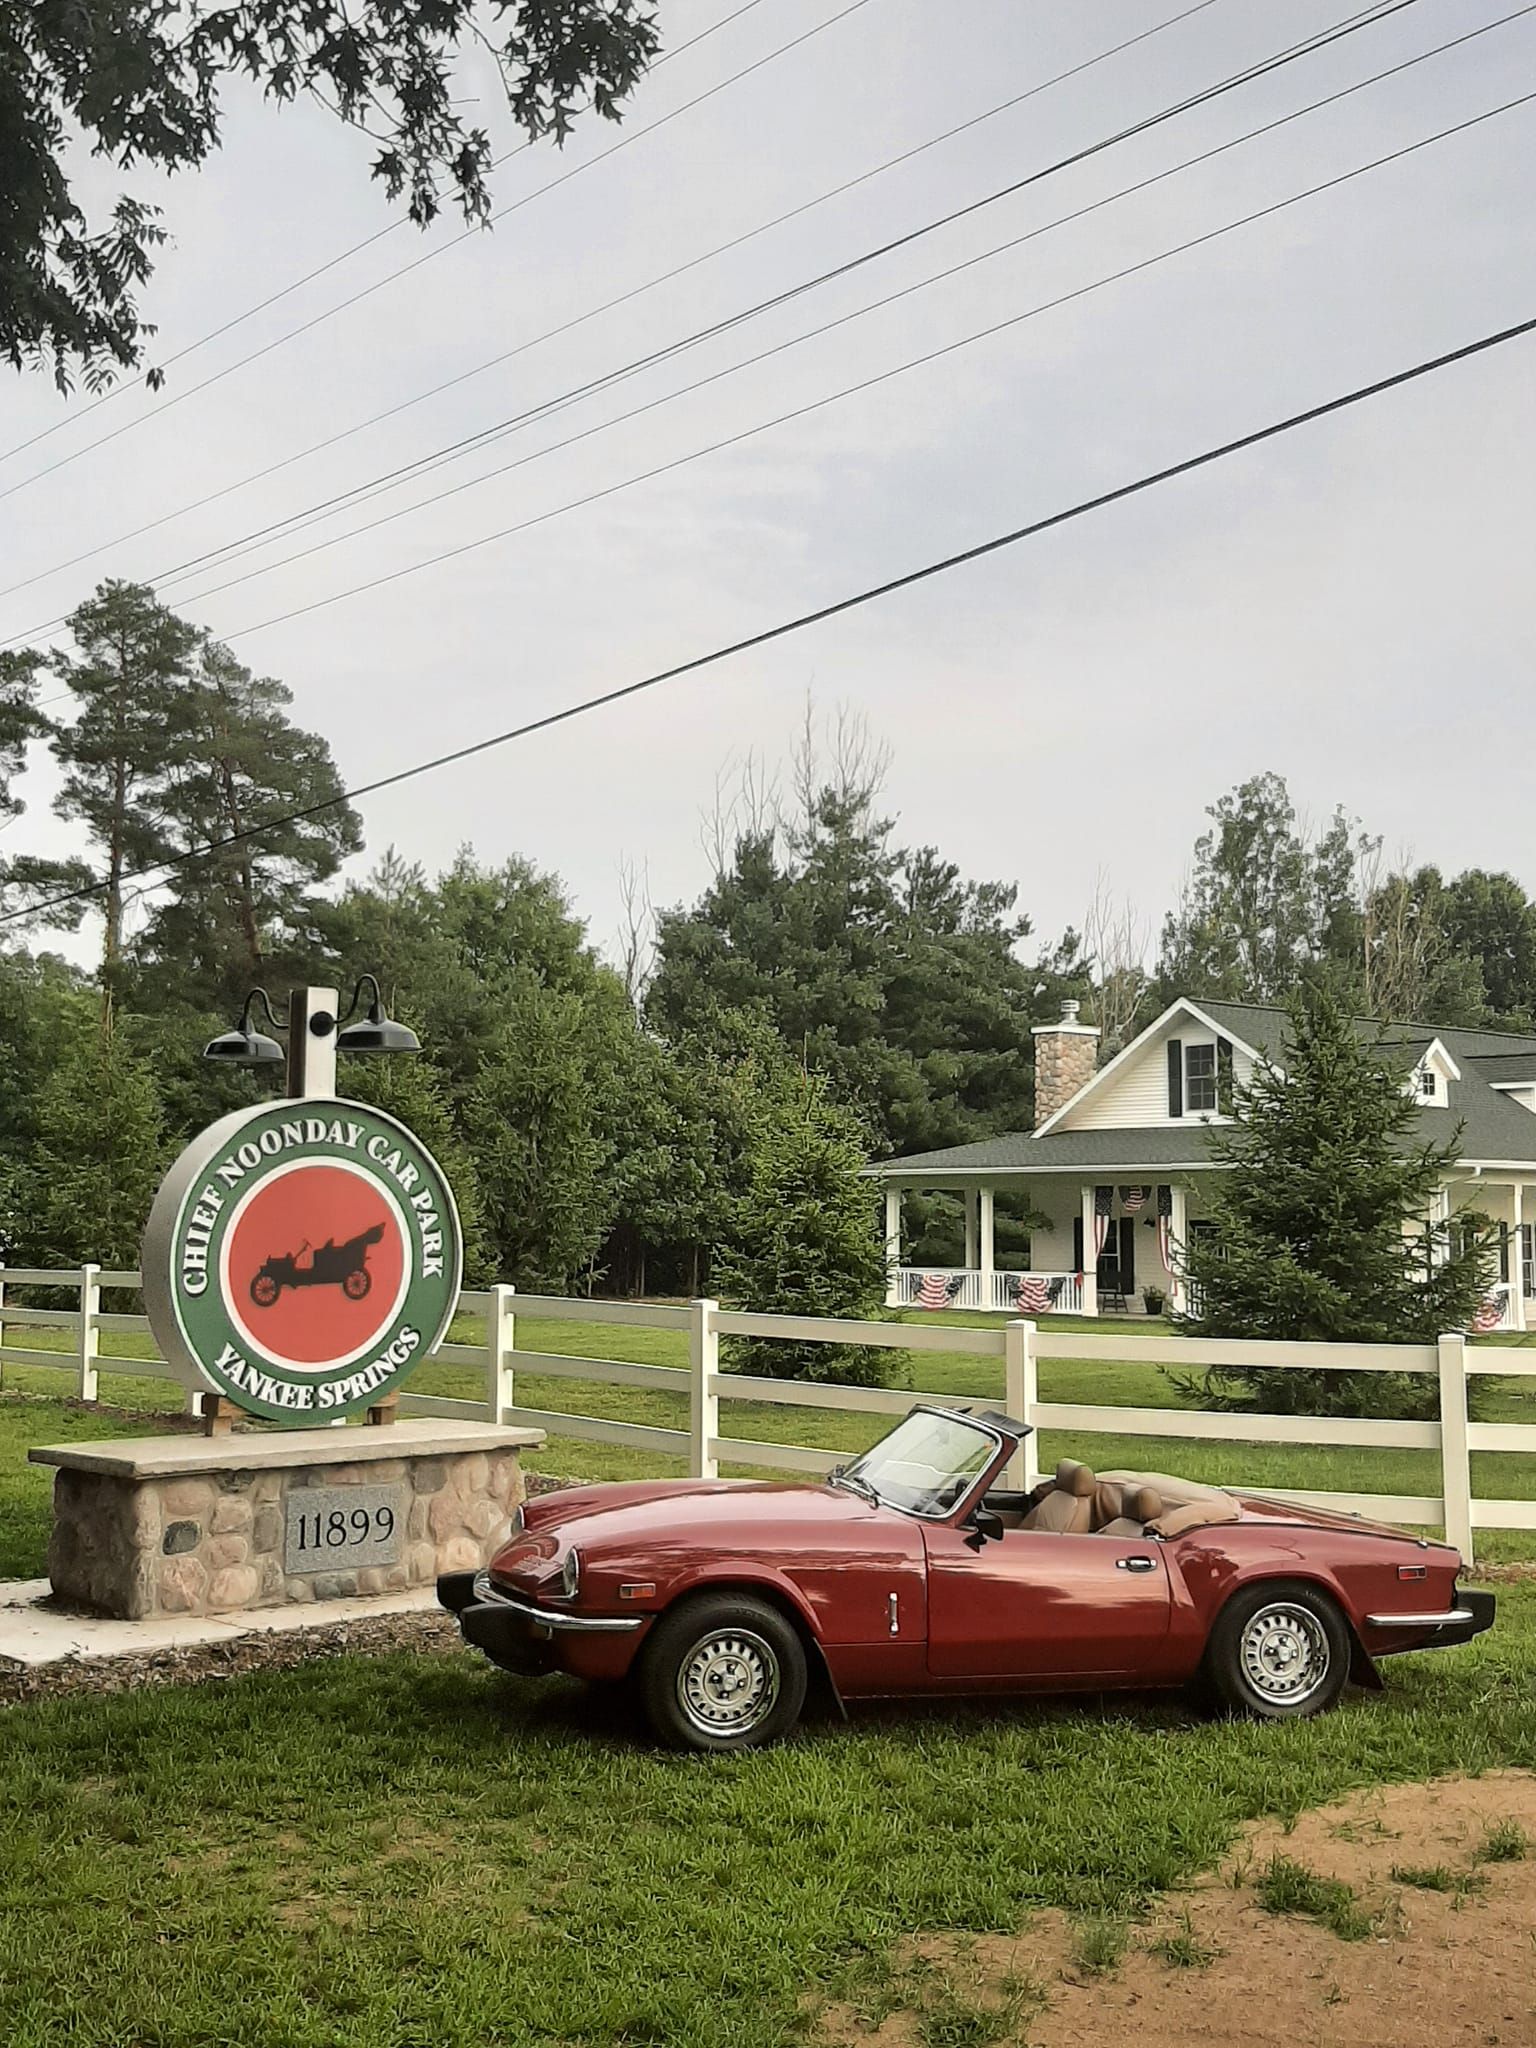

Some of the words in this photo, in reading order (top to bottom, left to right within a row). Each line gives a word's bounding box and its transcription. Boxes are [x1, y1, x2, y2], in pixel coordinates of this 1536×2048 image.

[183, 1184, 224, 1295] CHIEF
[217, 1119, 365, 1189] NOONDAY
[367, 1135, 421, 1193] CAR
[411, 1187, 444, 1279] PARK
[214, 1342, 314, 1409] YANKEE
[318, 1325, 420, 1408] SPRINGS
[298, 1506, 394, 1550] 11899
